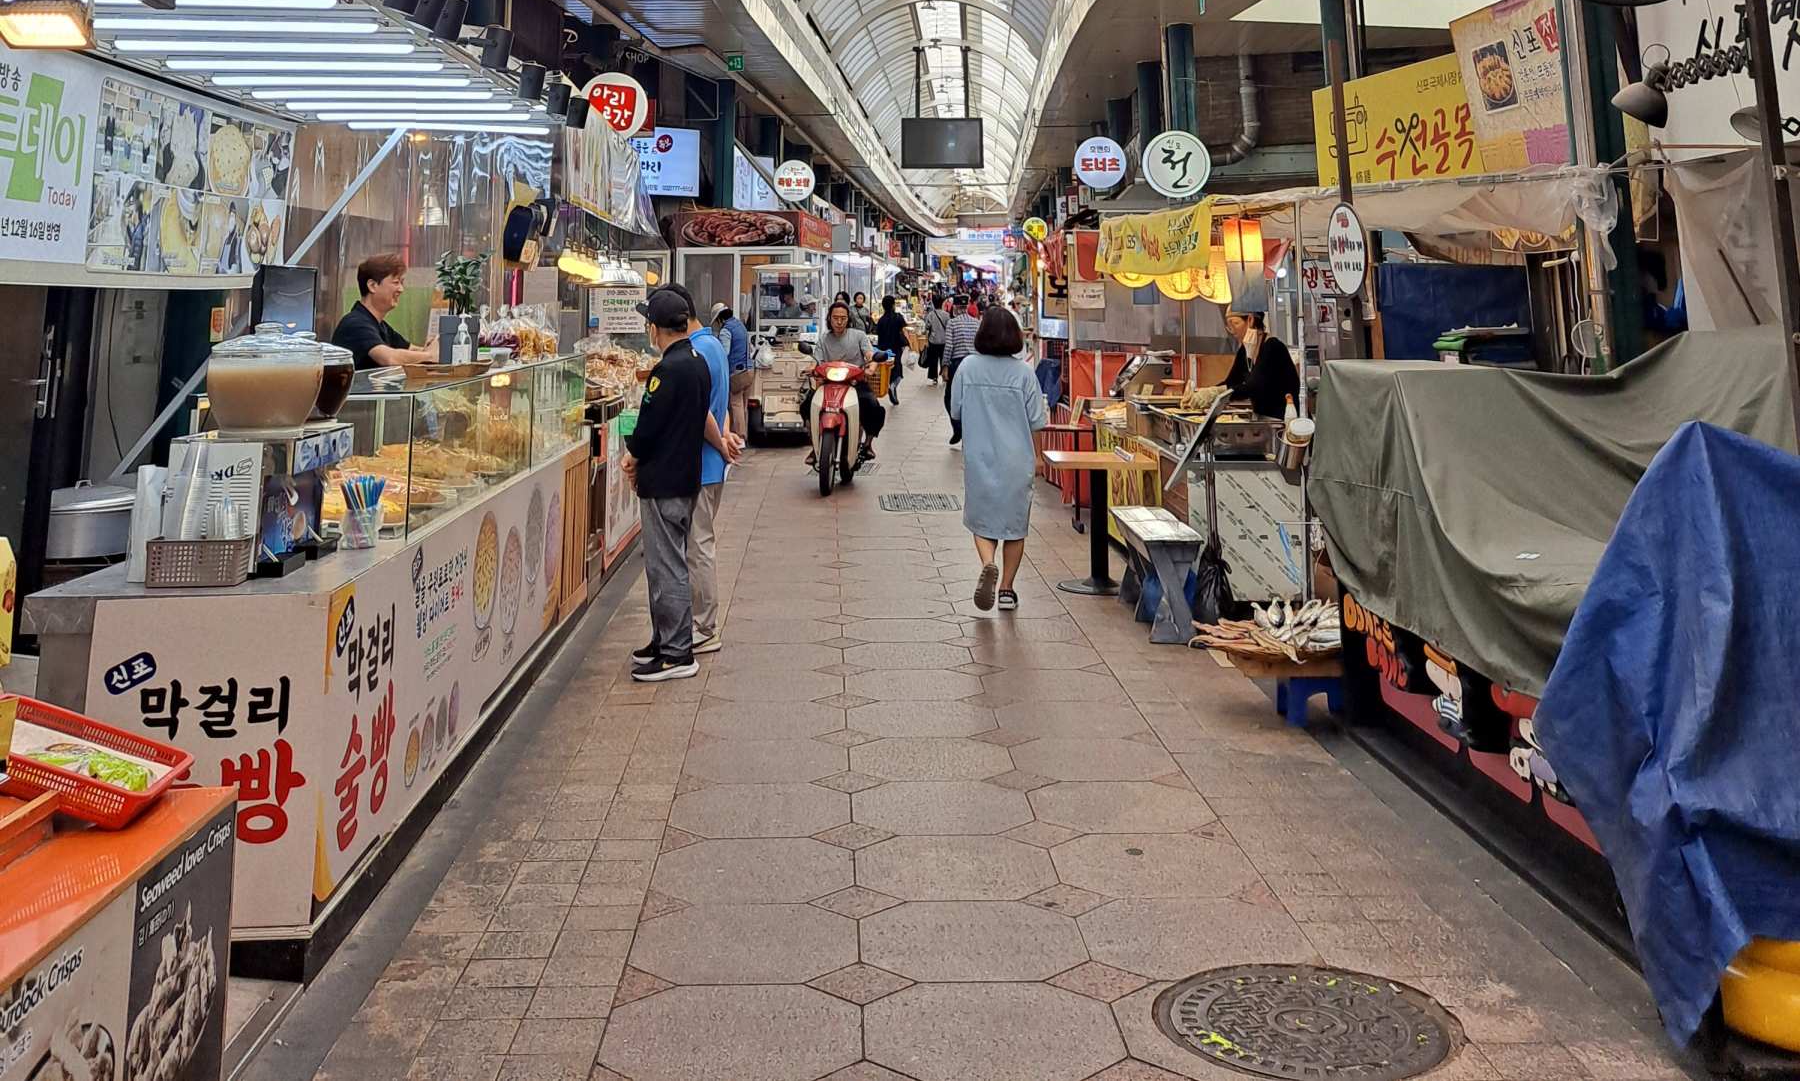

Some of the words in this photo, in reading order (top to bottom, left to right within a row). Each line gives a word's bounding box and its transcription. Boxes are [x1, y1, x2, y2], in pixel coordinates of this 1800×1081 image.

[593, 85, 625, 106] 아리
[1081, 157, 1120, 172] 도너츠
[47, 186, 77, 211] Today
[28, 220, 46, 242] 16일
[46, 223, 61, 242] 방영
[338, 602, 354, 649] 신포
[111, 658, 153, 689] 신포
[347, 602, 396, 704] 막걸리
[140, 675, 290, 741] 막걸리
[334, 678, 396, 852] 술빵
[140, 858, 185, 913] Seaweed
[207, 821, 232, 851] Crisps
[47, 948, 83, 993] Crisps
